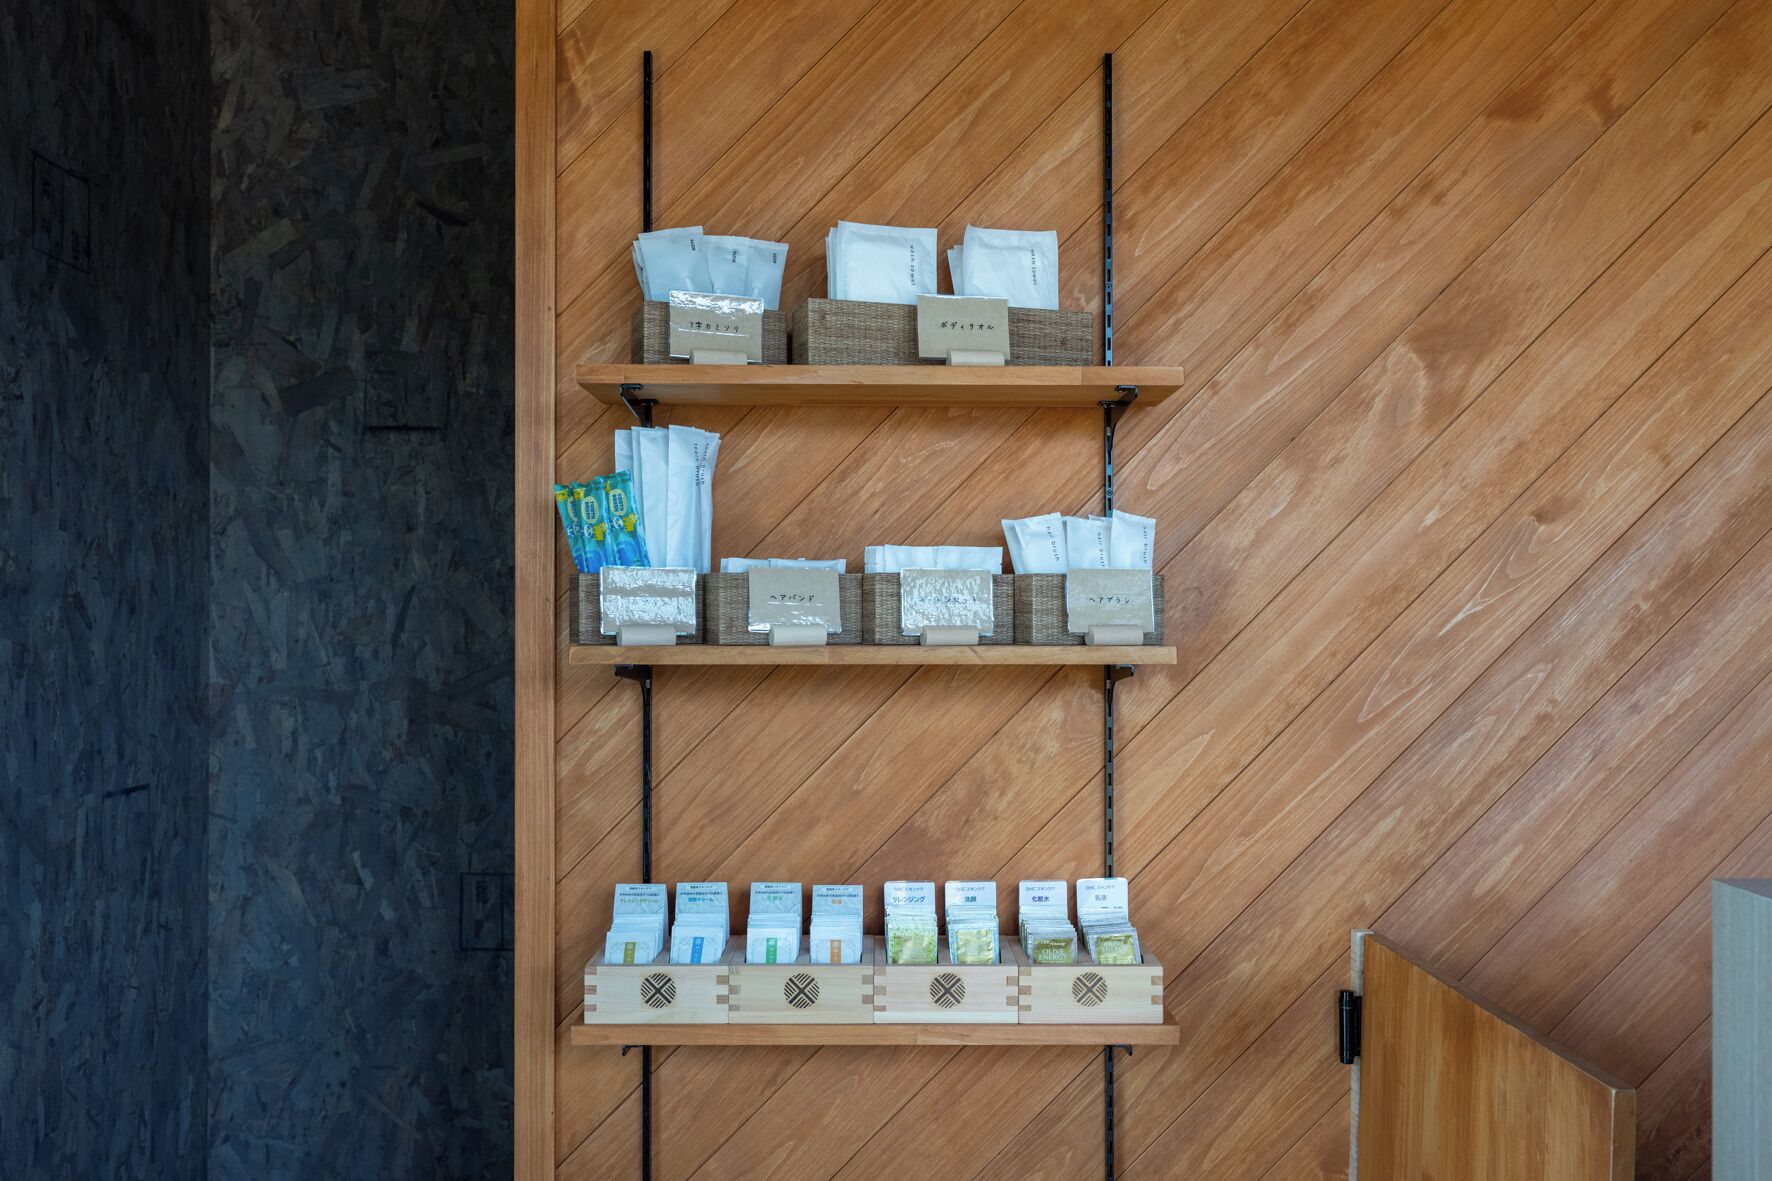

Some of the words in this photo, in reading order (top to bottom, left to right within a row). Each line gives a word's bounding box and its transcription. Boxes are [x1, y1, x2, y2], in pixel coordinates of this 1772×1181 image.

[940, 320, 994, 331] ボディタオル
[769, 593, 815, 602] ヘアバンド
